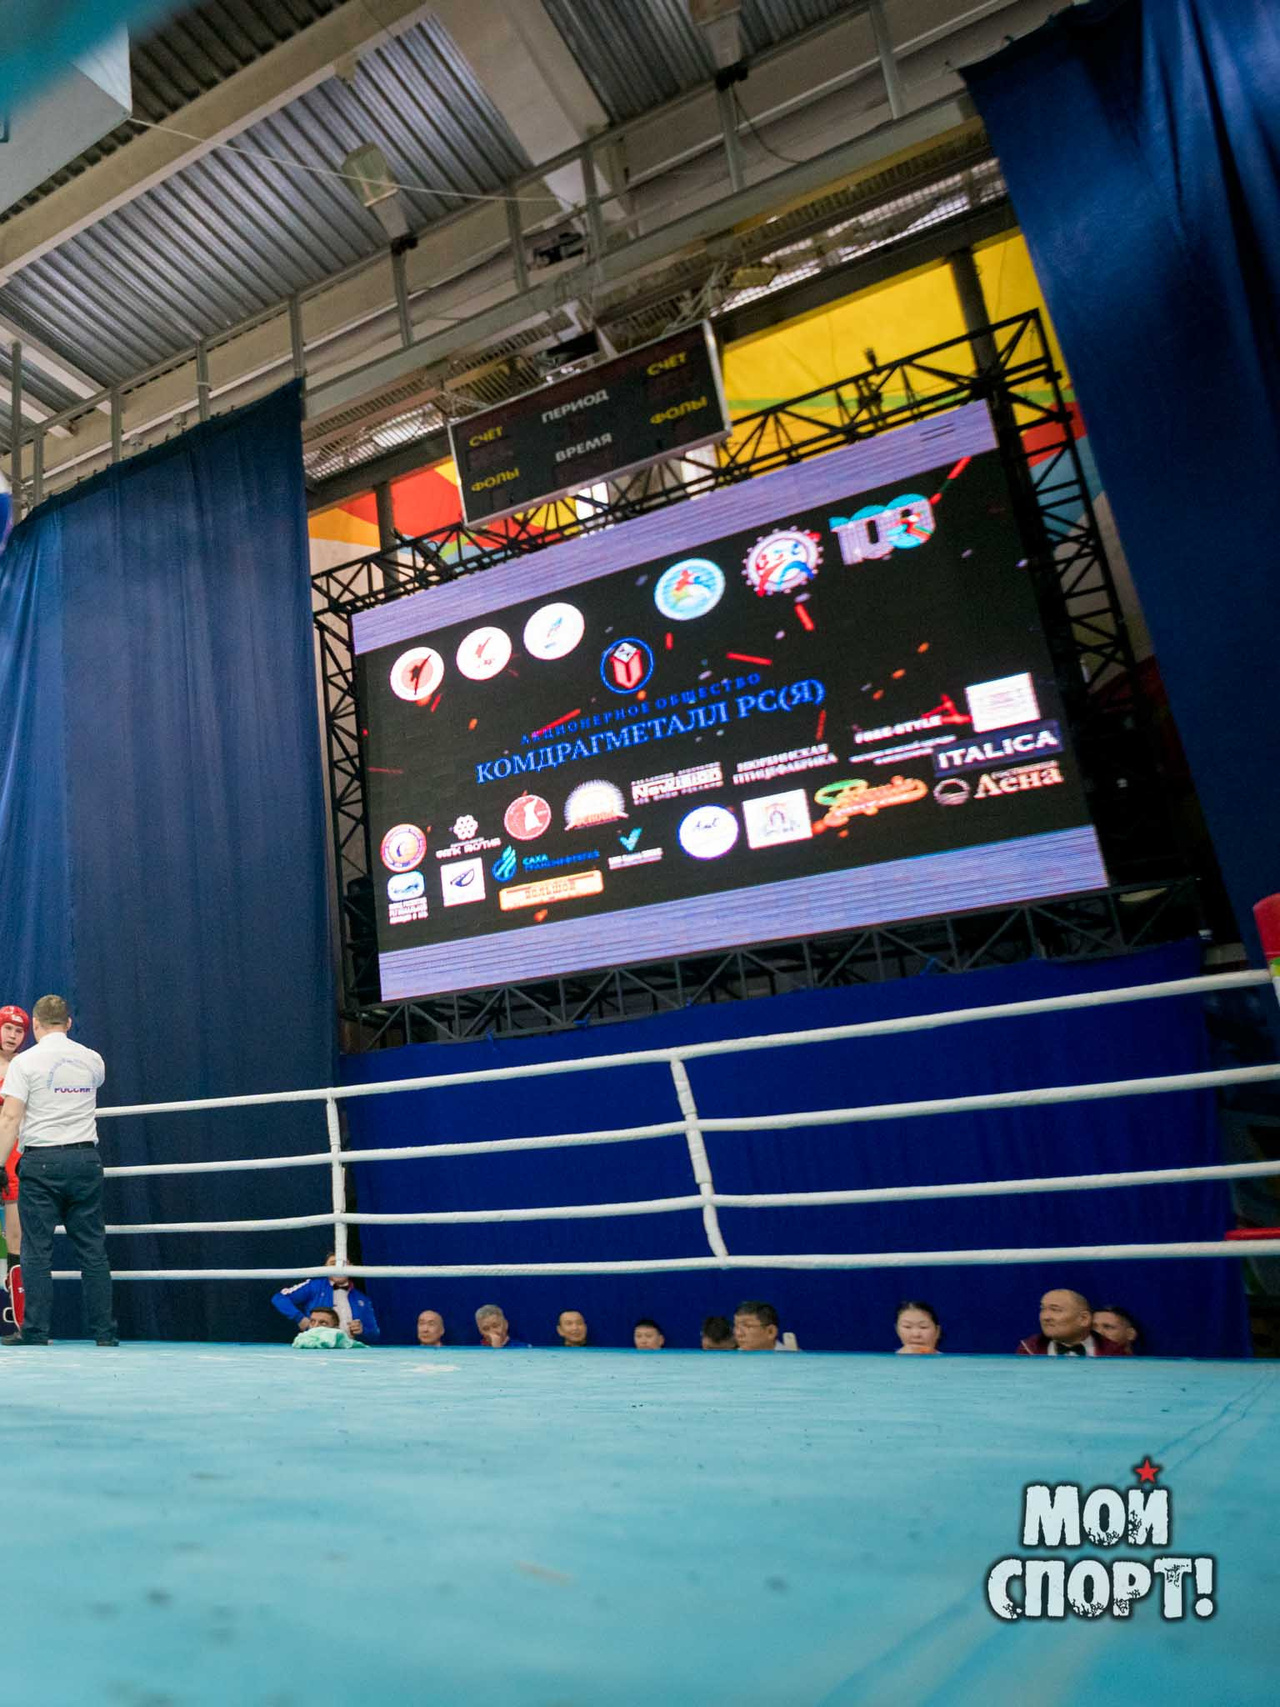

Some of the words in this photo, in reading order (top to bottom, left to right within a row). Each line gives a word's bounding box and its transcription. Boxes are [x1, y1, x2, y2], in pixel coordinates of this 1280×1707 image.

[541, 389, 610, 424] ПЕРИОД
[649, 396, 708, 425] ФОЛЫ
[555, 432, 613, 462] ВРЕМЯ
[471, 467, 519, 492] ФОЛЫ
[655, 672, 761, 708] ОБЩЕСТВО
[475, 701, 730, 784] КОМДРАГМЕТАЛЛ
[735, 678, 826, 719] РС(Я)
[938, 730, 1060, 769] ITALICA
